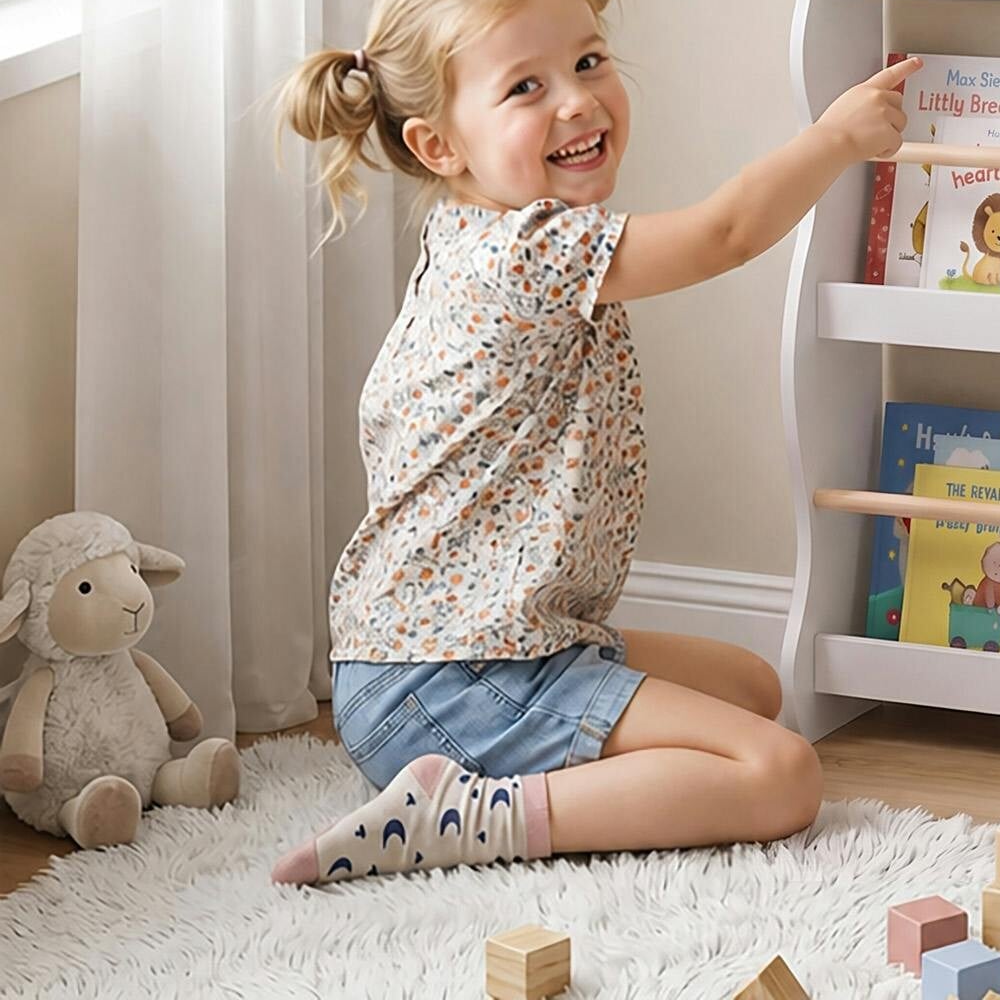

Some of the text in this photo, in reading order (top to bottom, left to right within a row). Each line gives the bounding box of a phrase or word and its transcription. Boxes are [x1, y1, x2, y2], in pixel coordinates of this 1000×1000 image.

[945, 68, 977, 87] Max
[917, 89, 965, 118] Littly
[945, 482, 967, 498] THE
